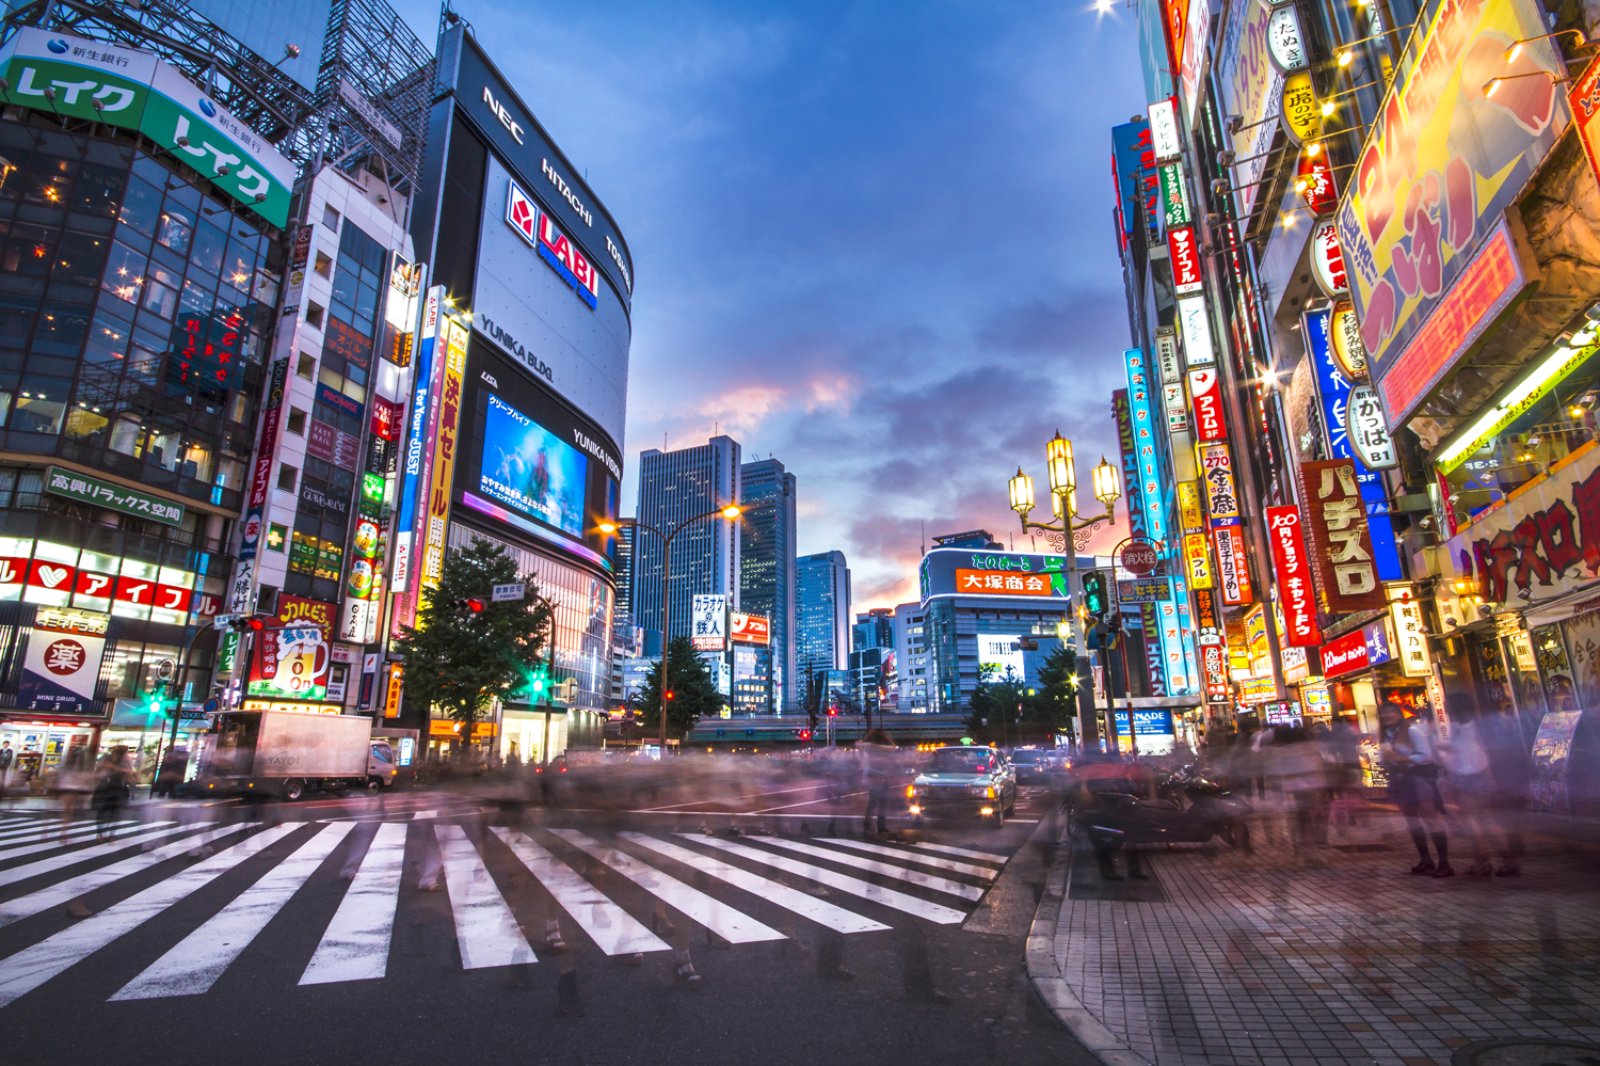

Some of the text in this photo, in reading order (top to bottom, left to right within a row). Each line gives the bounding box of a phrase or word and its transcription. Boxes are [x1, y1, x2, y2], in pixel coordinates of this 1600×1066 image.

[71, 47, 129, 67] 新生銀行
[17, 67, 135, 112] レイク
[484, 86, 524, 145] NEC
[218, 116, 262, 154] 新生銀行
[173, 115, 270, 200] レイク
[542, 158, 592, 228] HITACHI
[540, 212, 598, 298] LABI
[1175, 241, 1196, 283] アイフル
[482, 313, 526, 362] YUNIKA
[527, 353, 555, 384] BLDG.
[416, 388, 427, 406] For
[1200, 396, 1218, 429] アコム
[1359, 400, 1389, 447] かっぱ
[407, 438, 422, 476] JUST
[573, 428, 605, 462] YUNIKA
[1205, 456, 1229, 468] 270
[1370, 452, 1390, 462] B1
[252, 459, 270, 505] アイフル
[1208, 468, 1236, 514] 金の蔵
[1318, 465, 1376, 596] パチスロ
[972, 554, 1033, 571] たのめーる
[1124, 551, 1155, 565] 消火栓
[1217, 531, 1238, 600] 東京チカラめし
[963, 574, 1043, 591] 大塚商会
[695, 597, 723, 611] カラオケ
[706, 612, 713, 621] の
[696, 621, 720, 635] 鉄人
[749, 621, 767, 631] アコム
[48, 643, 83, 670] 薬
[1147, 643, 1166, 696] エスパス
[1115, 712, 1165, 721] SUNADE
